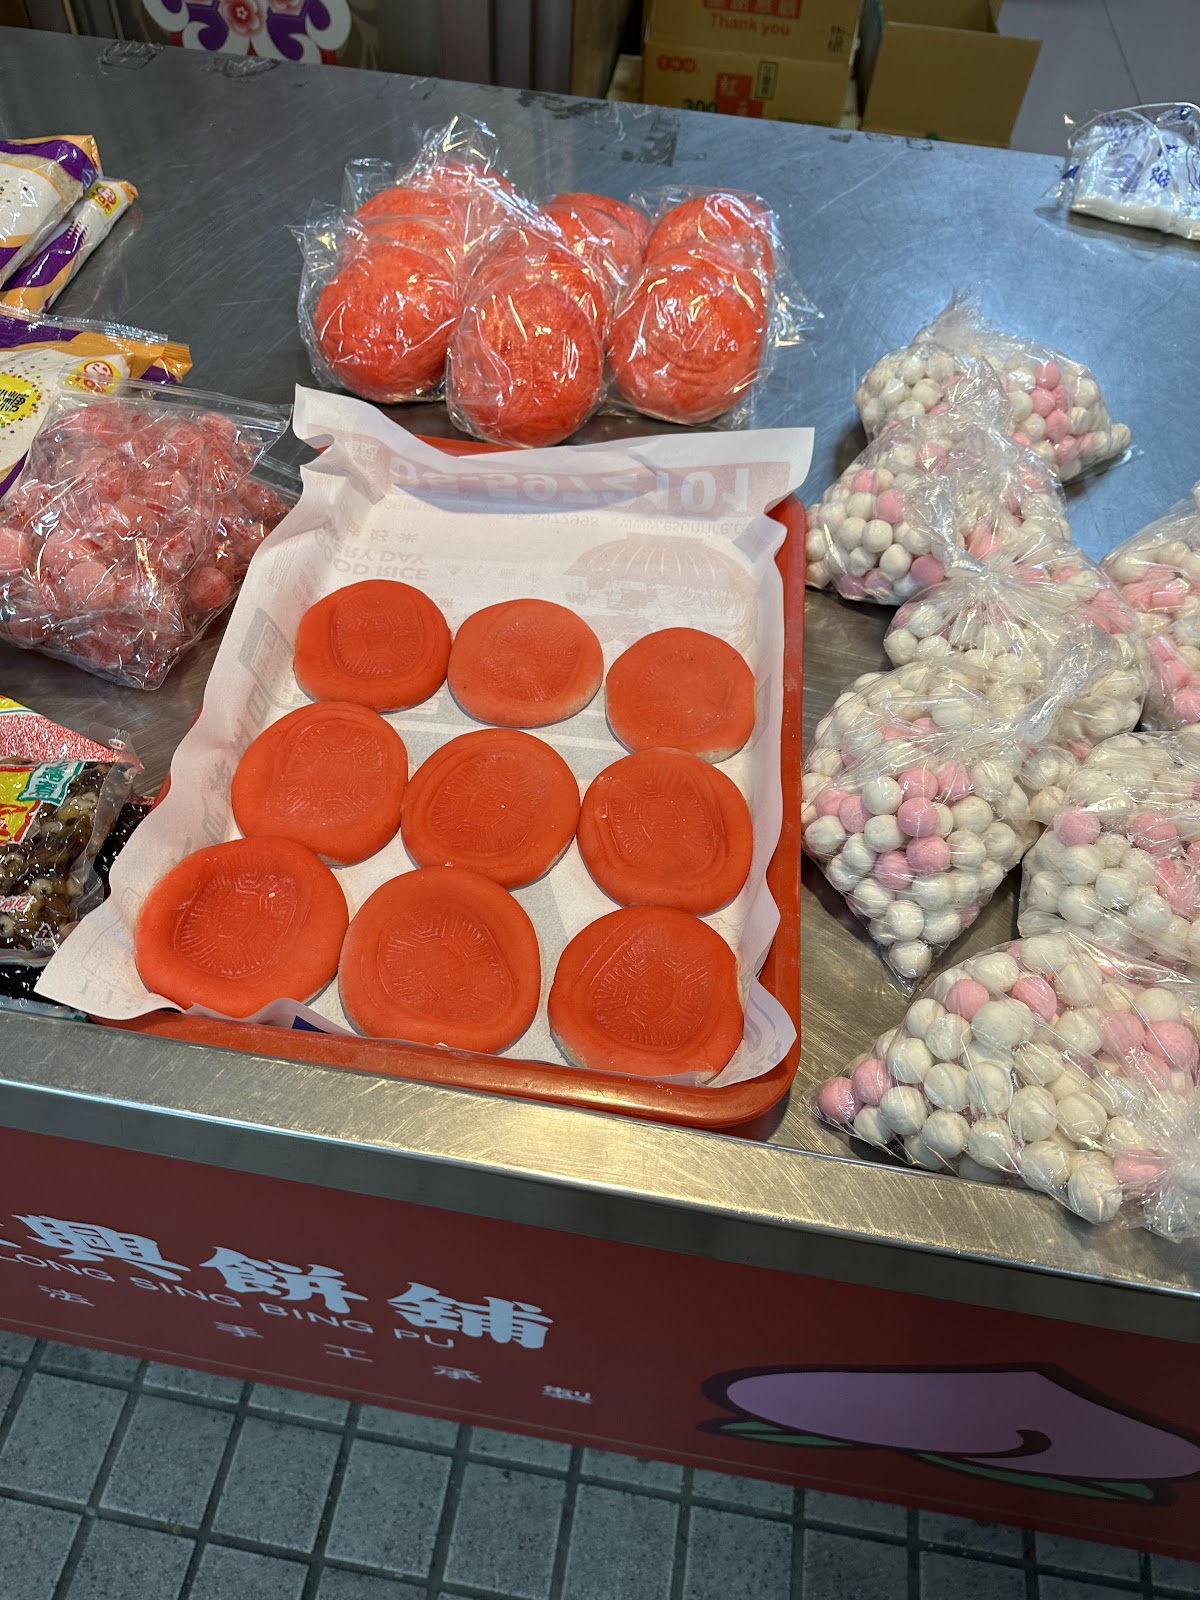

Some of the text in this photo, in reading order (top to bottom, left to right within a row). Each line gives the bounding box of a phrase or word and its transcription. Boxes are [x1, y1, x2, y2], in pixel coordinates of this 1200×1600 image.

[710, 13, 791, 38] Thank you
[0, 1213, 553, 1349] 興餅舖
[38, 1284, 95, 1307] 法
[130, 1276, 243, 1308] SING
[258, 1302, 375, 1334] BING
[394, 1328, 455, 1348] PU
